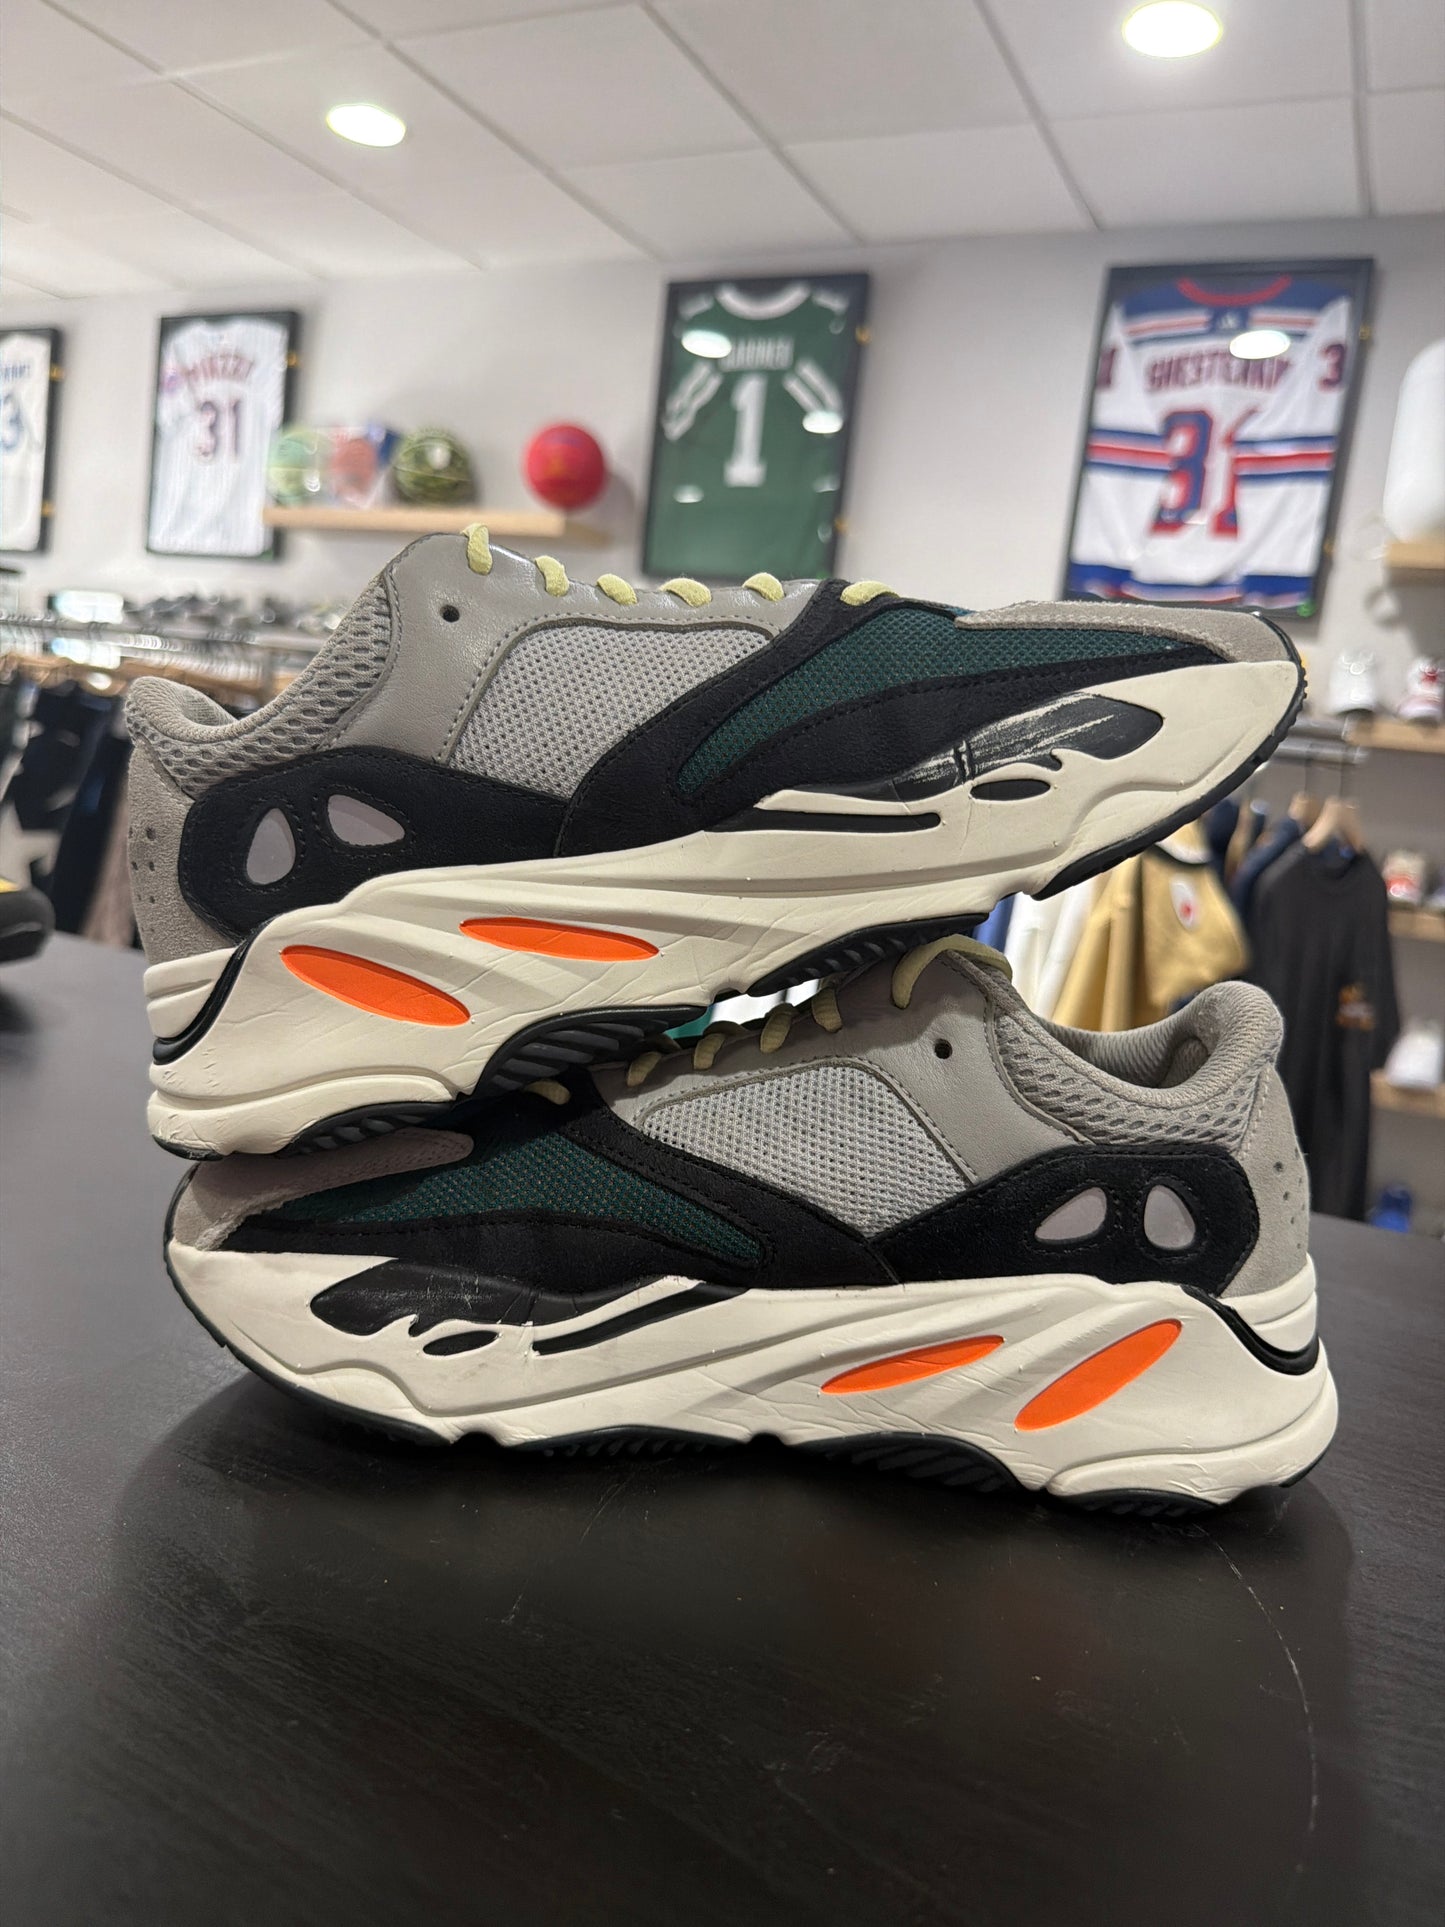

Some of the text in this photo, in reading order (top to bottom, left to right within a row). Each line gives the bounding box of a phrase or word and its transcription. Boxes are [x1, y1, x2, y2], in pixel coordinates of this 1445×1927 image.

[196, 399, 241, 459] 31
[724, 372, 768, 488] 1
[1150, 408, 1262, 538] 31
